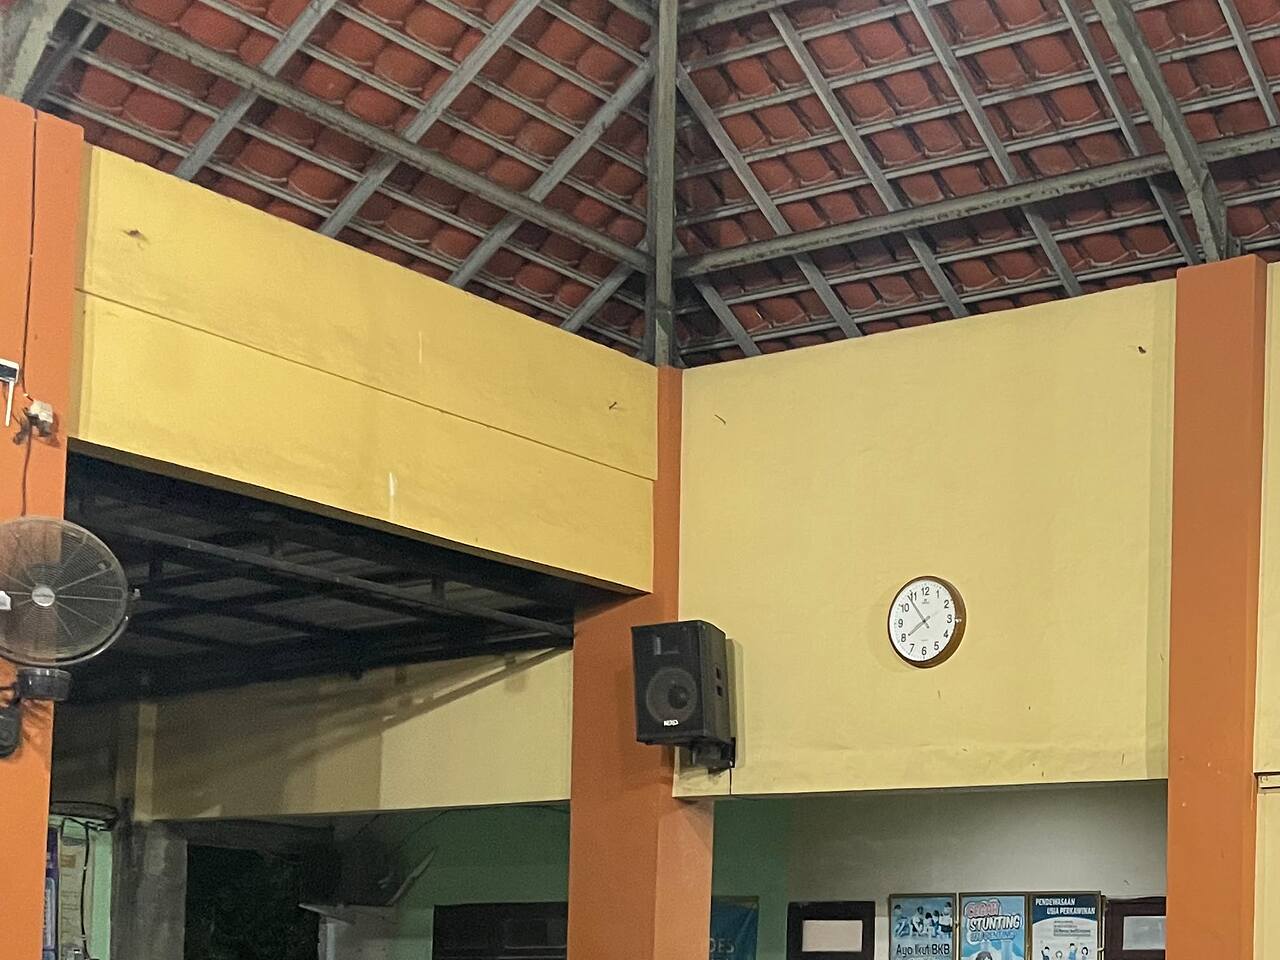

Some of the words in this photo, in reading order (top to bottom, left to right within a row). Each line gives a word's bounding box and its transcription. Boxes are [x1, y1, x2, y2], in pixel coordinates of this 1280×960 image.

[921, 586, 930, 596] 12
[936, 590, 940, 599] 1
[901, 603, 909, 613] 10
[943, 599, 950, 609] 2
[898, 619, 903, 628] 9
[946, 614, 953, 624] 3
[900, 633, 907, 643] 8
[943, 629, 949, 638] 4
[909, 643, 915, 654] 7
[921, 646, 927, 656] 6
[933, 641, 940, 651] 5
[969, 915, 1020, 931] STUNTING
[896, 944, 913, 958] Ayo
[931, 943, 950, 955] BKB
